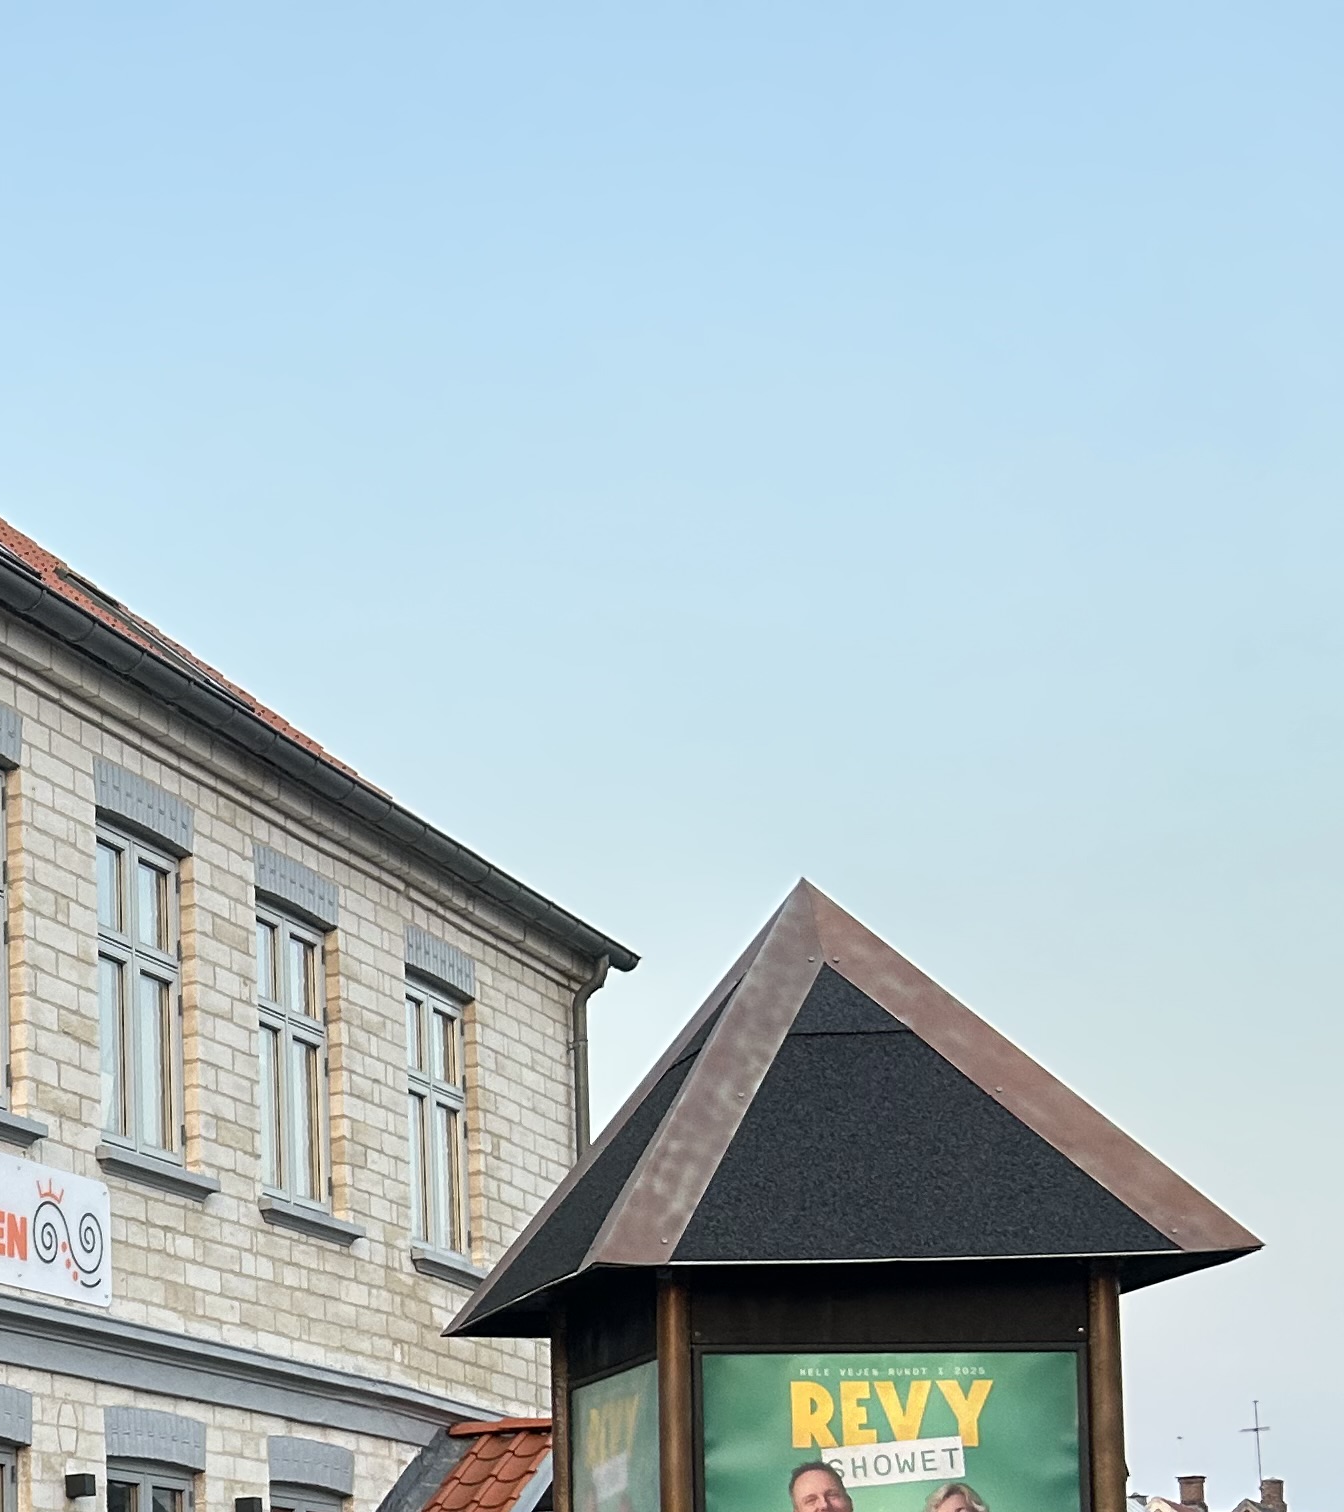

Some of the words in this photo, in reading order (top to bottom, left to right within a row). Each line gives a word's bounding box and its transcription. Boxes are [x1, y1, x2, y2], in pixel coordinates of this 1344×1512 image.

[954, 1367, 986, 1375] 2025
[790, 1379, 994, 1448] REVY
[828, 1447, 960, 1479] SHOWET
